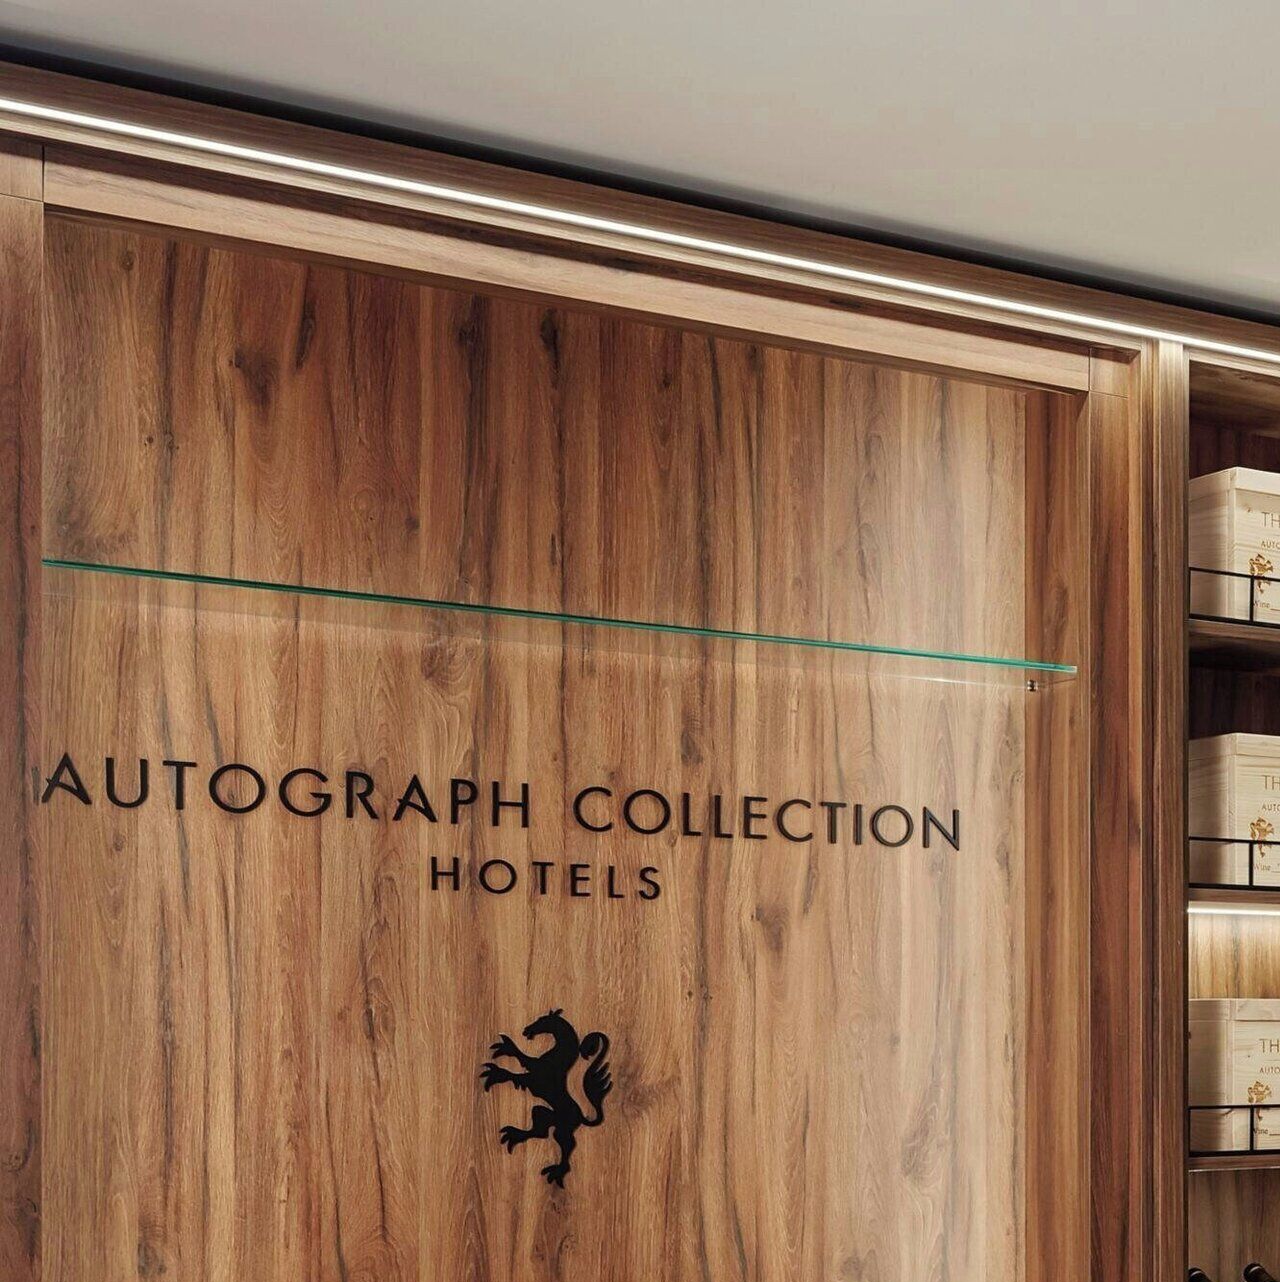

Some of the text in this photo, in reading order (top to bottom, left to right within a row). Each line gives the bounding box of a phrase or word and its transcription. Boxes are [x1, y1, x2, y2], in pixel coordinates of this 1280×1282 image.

[634, 616, 686, 629] DUNAVOX
[40, 753, 962, 851] AUTOGRAPH COLLECTION
[430, 856, 663, 900] HOTELS
